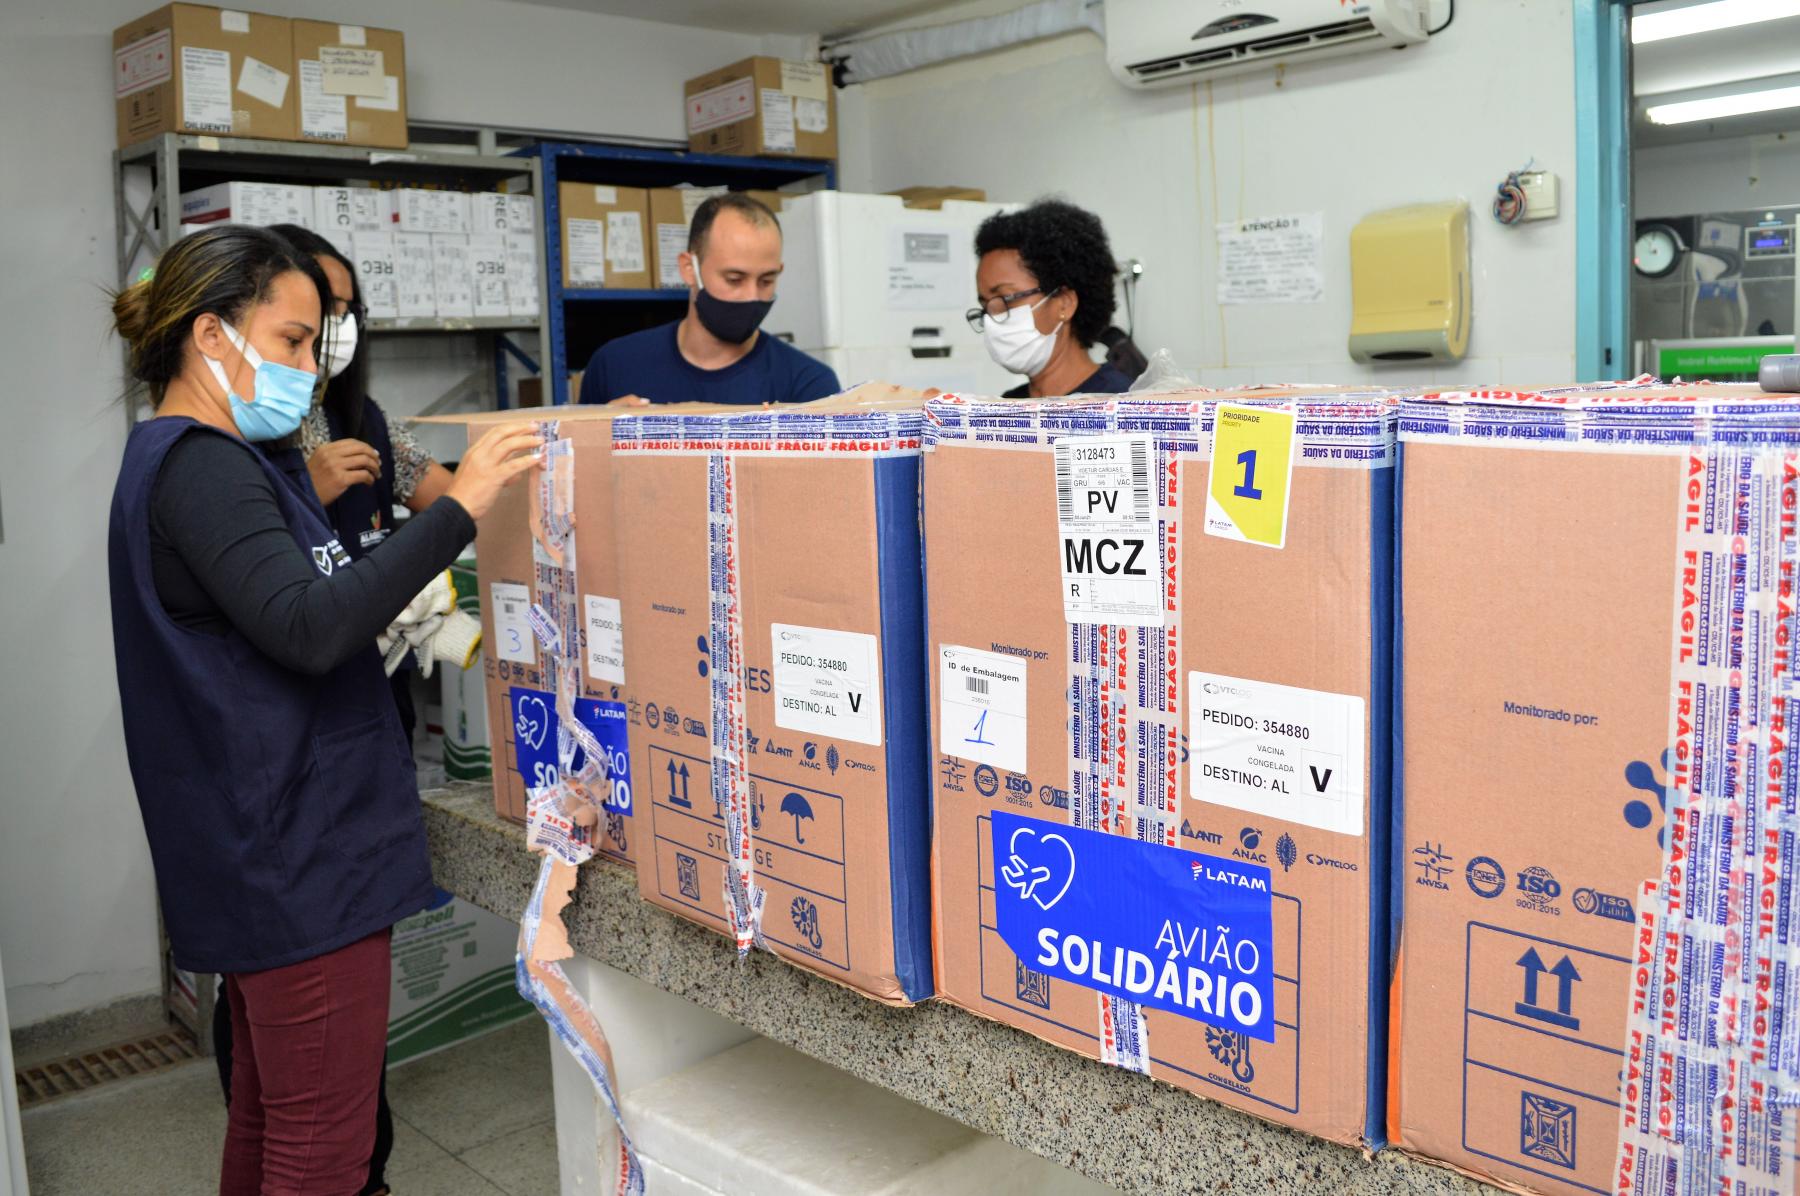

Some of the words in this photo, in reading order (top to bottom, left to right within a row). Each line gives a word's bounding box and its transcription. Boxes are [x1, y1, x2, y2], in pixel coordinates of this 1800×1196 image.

[336, 189, 350, 226] REC
[494, 196, 508, 230] REC
[1242, 218, 1290, 232] ATENÇÃO
[362, 260, 393, 274] REC
[476, 260, 506, 274] REC
[1071, 420, 1107, 430] MINISTÉRIO
[1117, 421, 1138, 431] SAÚDE
[1139, 421, 1149, 430] DA
[1151, 421, 1190, 432] MINISTÉRIO
[1223, 412, 1260, 423] PRIORIDADE
[1322, 425, 1333, 434] DA
[1401, 422, 1448, 434] MINISTÉRIO
[1464, 425, 1492, 438] SAÚDE
[1496, 425, 1508, 436] DA
[1511, 425, 1566, 439] MINISTÉRIO
[1582, 428, 1613, 442] SAÚDE
[1617, 429, 1630, 440] DA
[1634, 429, 1694, 442] MINISTÉRIO
[1712, 431, 1747, 444] SAÚDE
[1753, 431, 1767, 442] DA
[778, 440, 824, 450] FRÁGIL
[832, 439, 890, 451] FRÁGIL
[1005, 434, 1038, 444] MINISTÉRIO
[1159, 441, 1198, 452] MINISTÉRIO
[1076, 448, 1115, 460] 3128473
[1303, 448, 1328, 459] SAÚDE
[1330, 449, 1341, 458] DA
[1234, 450, 1262, 500] 1
[1739, 484, 1750, 496] DA
[1088, 490, 1118, 514] PV
[1737, 501, 1752, 536] SAÚDE
[1065, 538, 1146, 575] MCZ
[1165, 521, 1177, 611] FRÁGIL
[1071, 584, 1080, 597] R
[1733, 554, 1748, 618] MINISTÉRIO
[1680, 550, 1699, 663] FRÁGIL
[1698, 551, 1712, 666] IMUNOBIOLÓGICOS
[1732, 619, 1743, 631] DA
[1773, 561, 1796, 678] FRÁGIL
[506, 628, 522, 653] 3
[991, 642, 1032, 657] Monitorado
[1034, 650, 1049, 660] por:
[1138, 649, 1145, 660] DA
[1729, 635, 1744, 670] SAÚDE
[781, 652, 816, 668] PEDIDO:
[818, 658, 848, 672] 354880
[1166, 625, 1176, 713] FRÁGIL
[1749, 610, 1759, 726] IMUNOBIOLÓGICOS
[815, 678, 833, 686] VACINA
[972, 667, 1020, 682] Embalagem
[810, 689, 840, 699] CONGELADA
[1137, 662, 1146, 708] MINISTÉRIO
[782, 697, 823, 714] DESTINO:
[825, 706, 837, 717] AL
[848, 692, 862, 713] V
[1074, 703, 1080, 712] DA
[600, 708, 626, 721] LATAM
[663, 712, 679, 725] ISO
[1098, 681, 1108, 764] FRÁGIL
[1504, 701, 1571, 721] Monitorado
[1574, 714, 1598, 726] por:
[1727, 687, 1742, 746] MINISTÉRIO
[964, 710, 995, 746] 1
[1137, 720, 1145, 746] SAÚDE
[1203, 709, 1258, 731] PEDIDO:
[1263, 720, 1310, 740] 354880
[1674, 680, 1693, 789] FRÁGIL
[1072, 714, 1080, 759] MINISTÉRIO
[1116, 704, 1126, 787] FRÁGIL
[1692, 683, 1706, 794] IMUNOBIOLÓGICOS
[1138, 748, 1145, 758] DA
[1256, 744, 1285, 757] VACINA
[1726, 750, 1737, 763] DA
[1767, 696, 1788, 810] FRÁGIL
[799, 760, 821, 770] ANAC
[1166, 726, 1176, 812] FRÁGIL
[1248, 757, 1295, 774] CONGELADA
[1005, 776, 1032, 794] ISO
[1137, 760, 1145, 805] MINISTÉRIO
[1203, 764, 1267, 789] DESTINO:
[1271, 779, 1290, 794] AL
[1309, 765, 1332, 793] V
[1724, 767, 1738, 799] SAÚDE
[1005, 796, 1033, 808] 9001:2015
[1074, 797, 1080, 808] DA
[1744, 743, 1756, 856] IMUNOBIOLÓGICOS
[741, 792, 750, 860] FRÁGIL
[1197, 830, 1223, 845] ANTT
[1719, 815, 1734, 875] MINISTÉRIO
[1232, 847, 1267, 863] ANAC
[1668, 807, 1687, 914] FRÁGIL
[1686, 810, 1700, 920] IMUNOBIOLÓGICOS
[1323, 859, 1358, 872] VTCLOG
[1206, 868, 1267, 892] LATAM
[1416, 877, 1449, 891] ANVISA
[1516, 872, 1561, 897] ISO
[1718, 877, 1729, 889] DA
[1759, 829, 1780, 939] FRÁGIL
[1516, 899, 1561, 916] 9001:2015
[1603, 896, 1627, 906] ISO
[1715, 894, 1729, 927] SAÚDE
[1742, 872, 1754, 983] IMUNOBIOLÓGICOS
[1154, 919, 1259, 975] AVIÃO
[1634, 912, 1653, 1014] FRÁGIL
[1710, 942, 1725, 999] MINISTÉRIO
[1037, 927, 1262, 1026] SOLIDÁRIO
[1661, 931, 1680, 1036] FRÁGIL
[1708, 1001, 1719, 1013] DA
[1751, 956, 1772, 1065] FRÁGIL
[1130, 1020, 1138, 1030] DA
[1132, 1032, 1141, 1057] SAÚDE
[1209, 1072, 1251, 1093] CONGELADO
[1624, 1029, 1642, 1127] FRÁGIL
[1640, 1034, 1654, 1134] IMUNOBIOLÓGICOS
[1770, 1130, 1781, 1143] DA
[1769, 1148, 1783, 1176] SAÚDE
